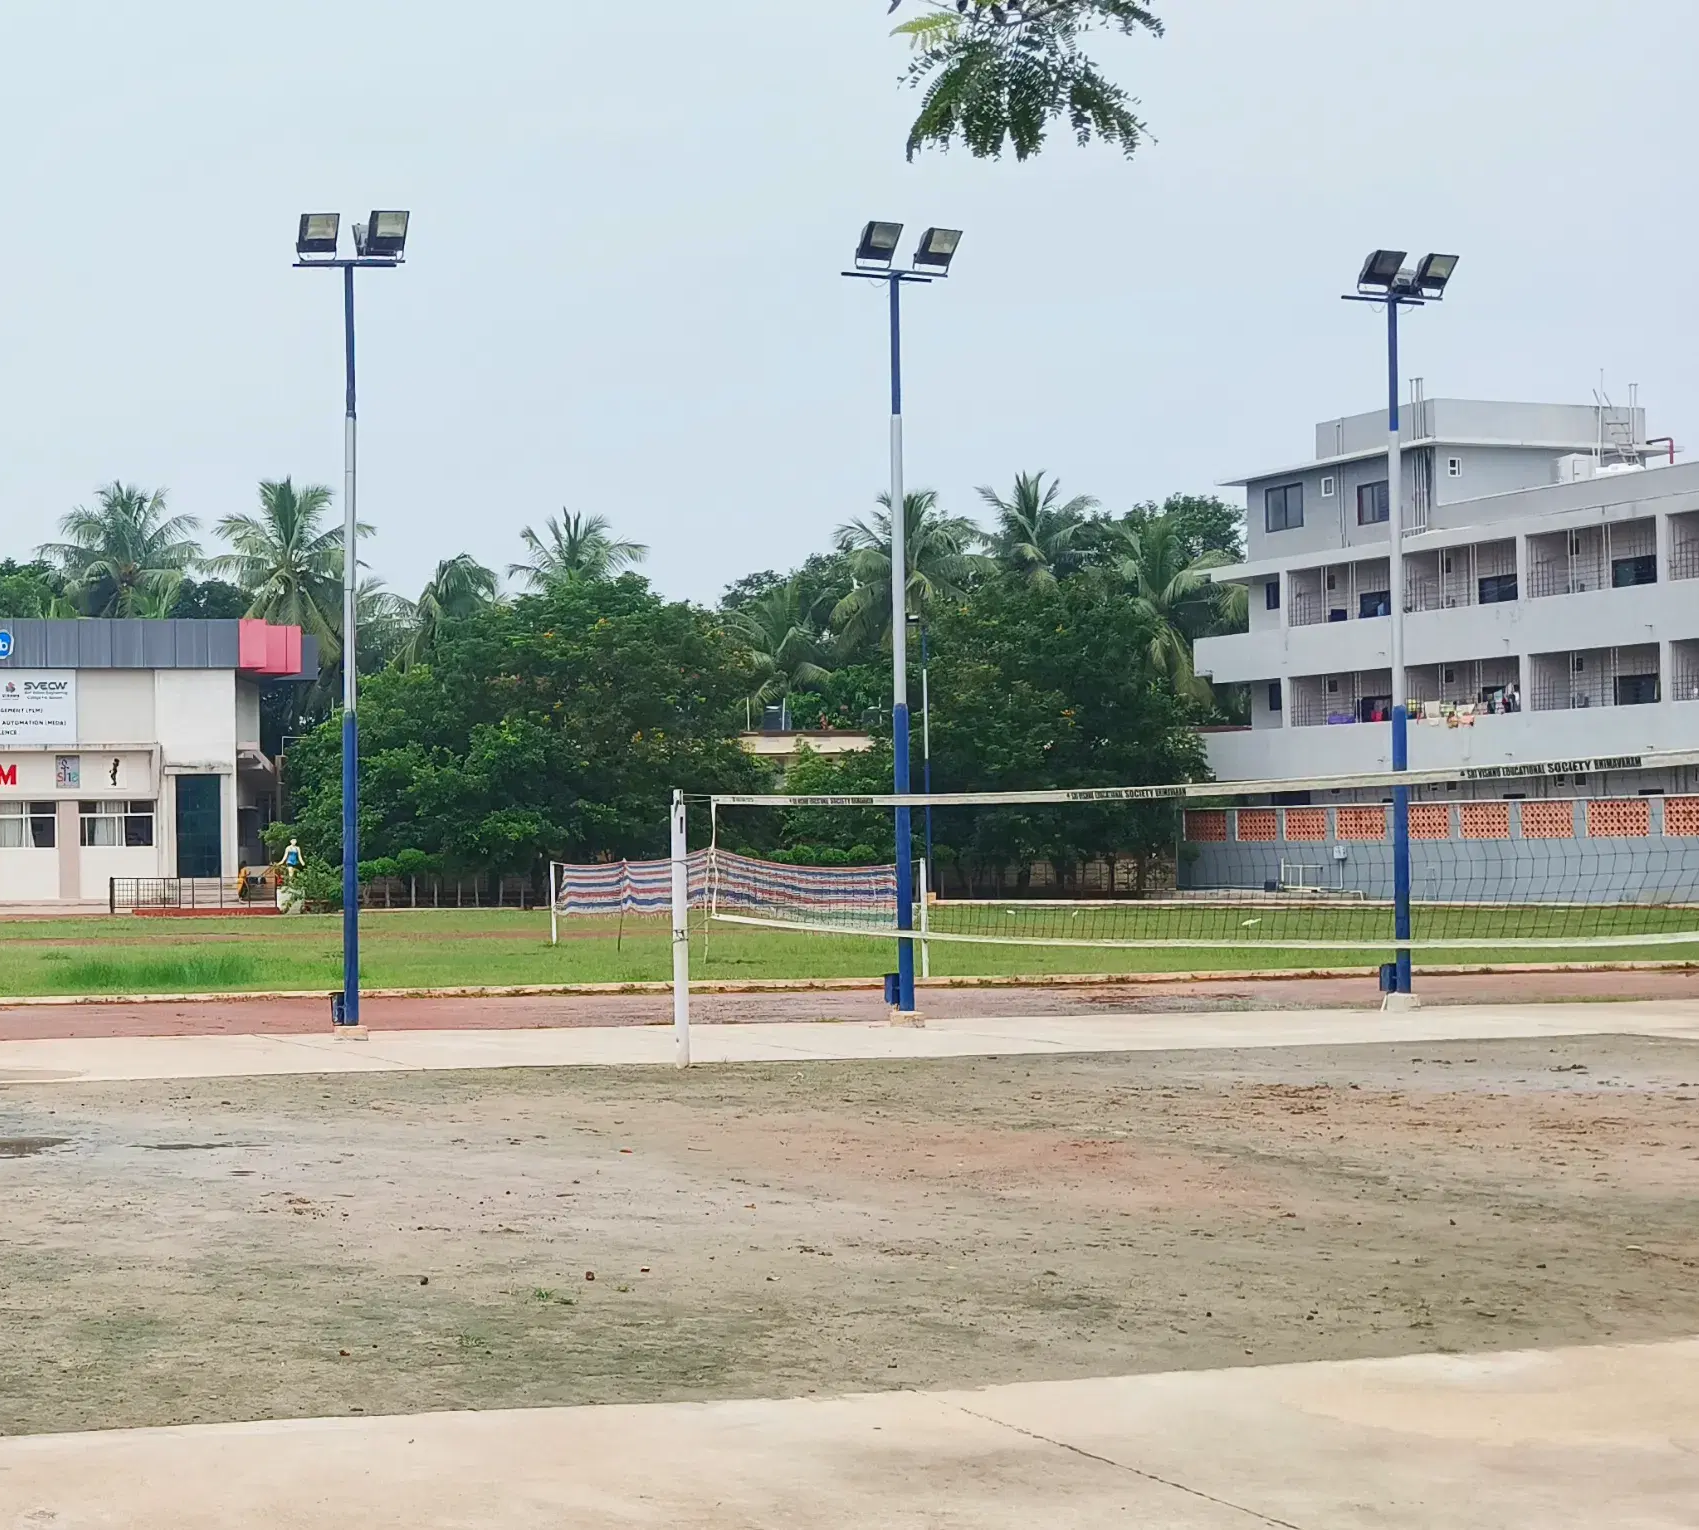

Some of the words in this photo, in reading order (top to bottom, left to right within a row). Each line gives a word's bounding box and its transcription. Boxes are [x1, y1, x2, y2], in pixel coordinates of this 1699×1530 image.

[24, 682, 68, 690] SVECW
[1547, 760, 1591, 773] SOCIETY
[1124, 789, 1154, 798] SOCIETY
